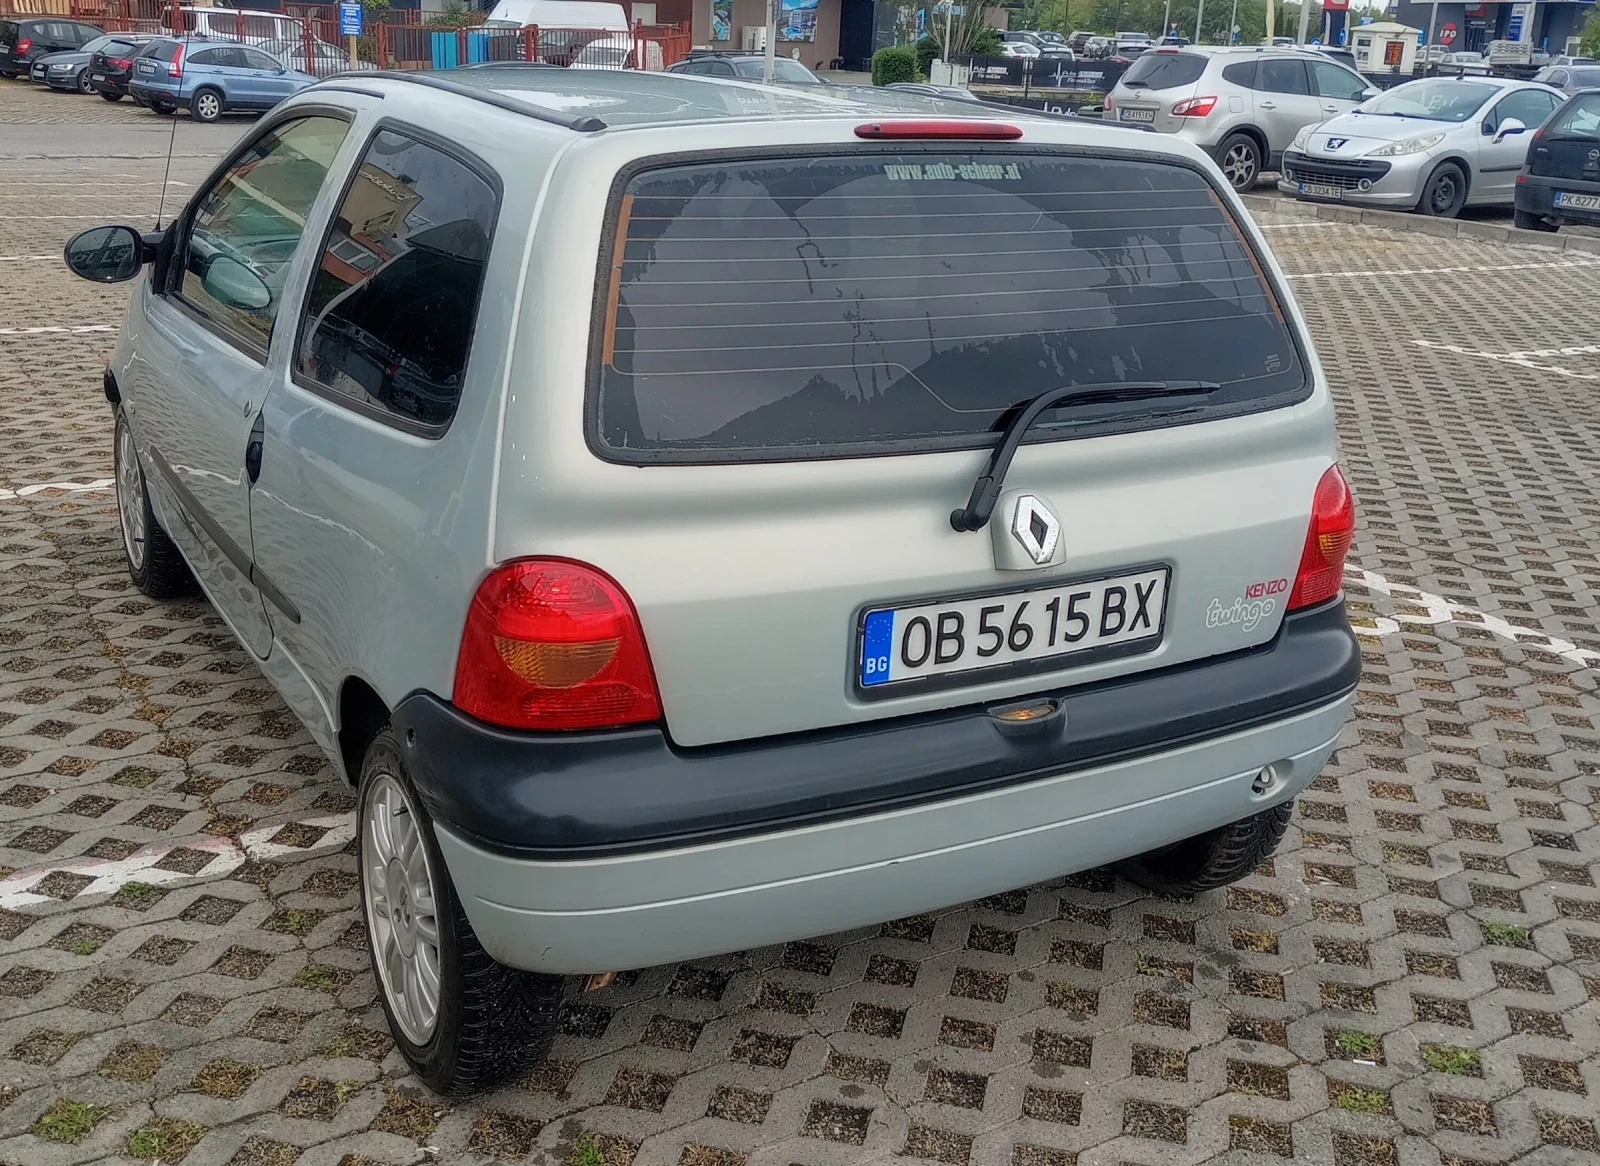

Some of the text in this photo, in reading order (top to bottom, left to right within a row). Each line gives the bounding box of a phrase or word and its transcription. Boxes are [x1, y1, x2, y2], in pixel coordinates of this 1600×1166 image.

[1440, 29, 1457, 38] IPO
[883, 162, 1022, 181] www.auto-scheer.at
[1245, 578, 1288, 600] KENZO
[1205, 596, 1276, 633] twingo
[866, 655, 888, 675] BG
